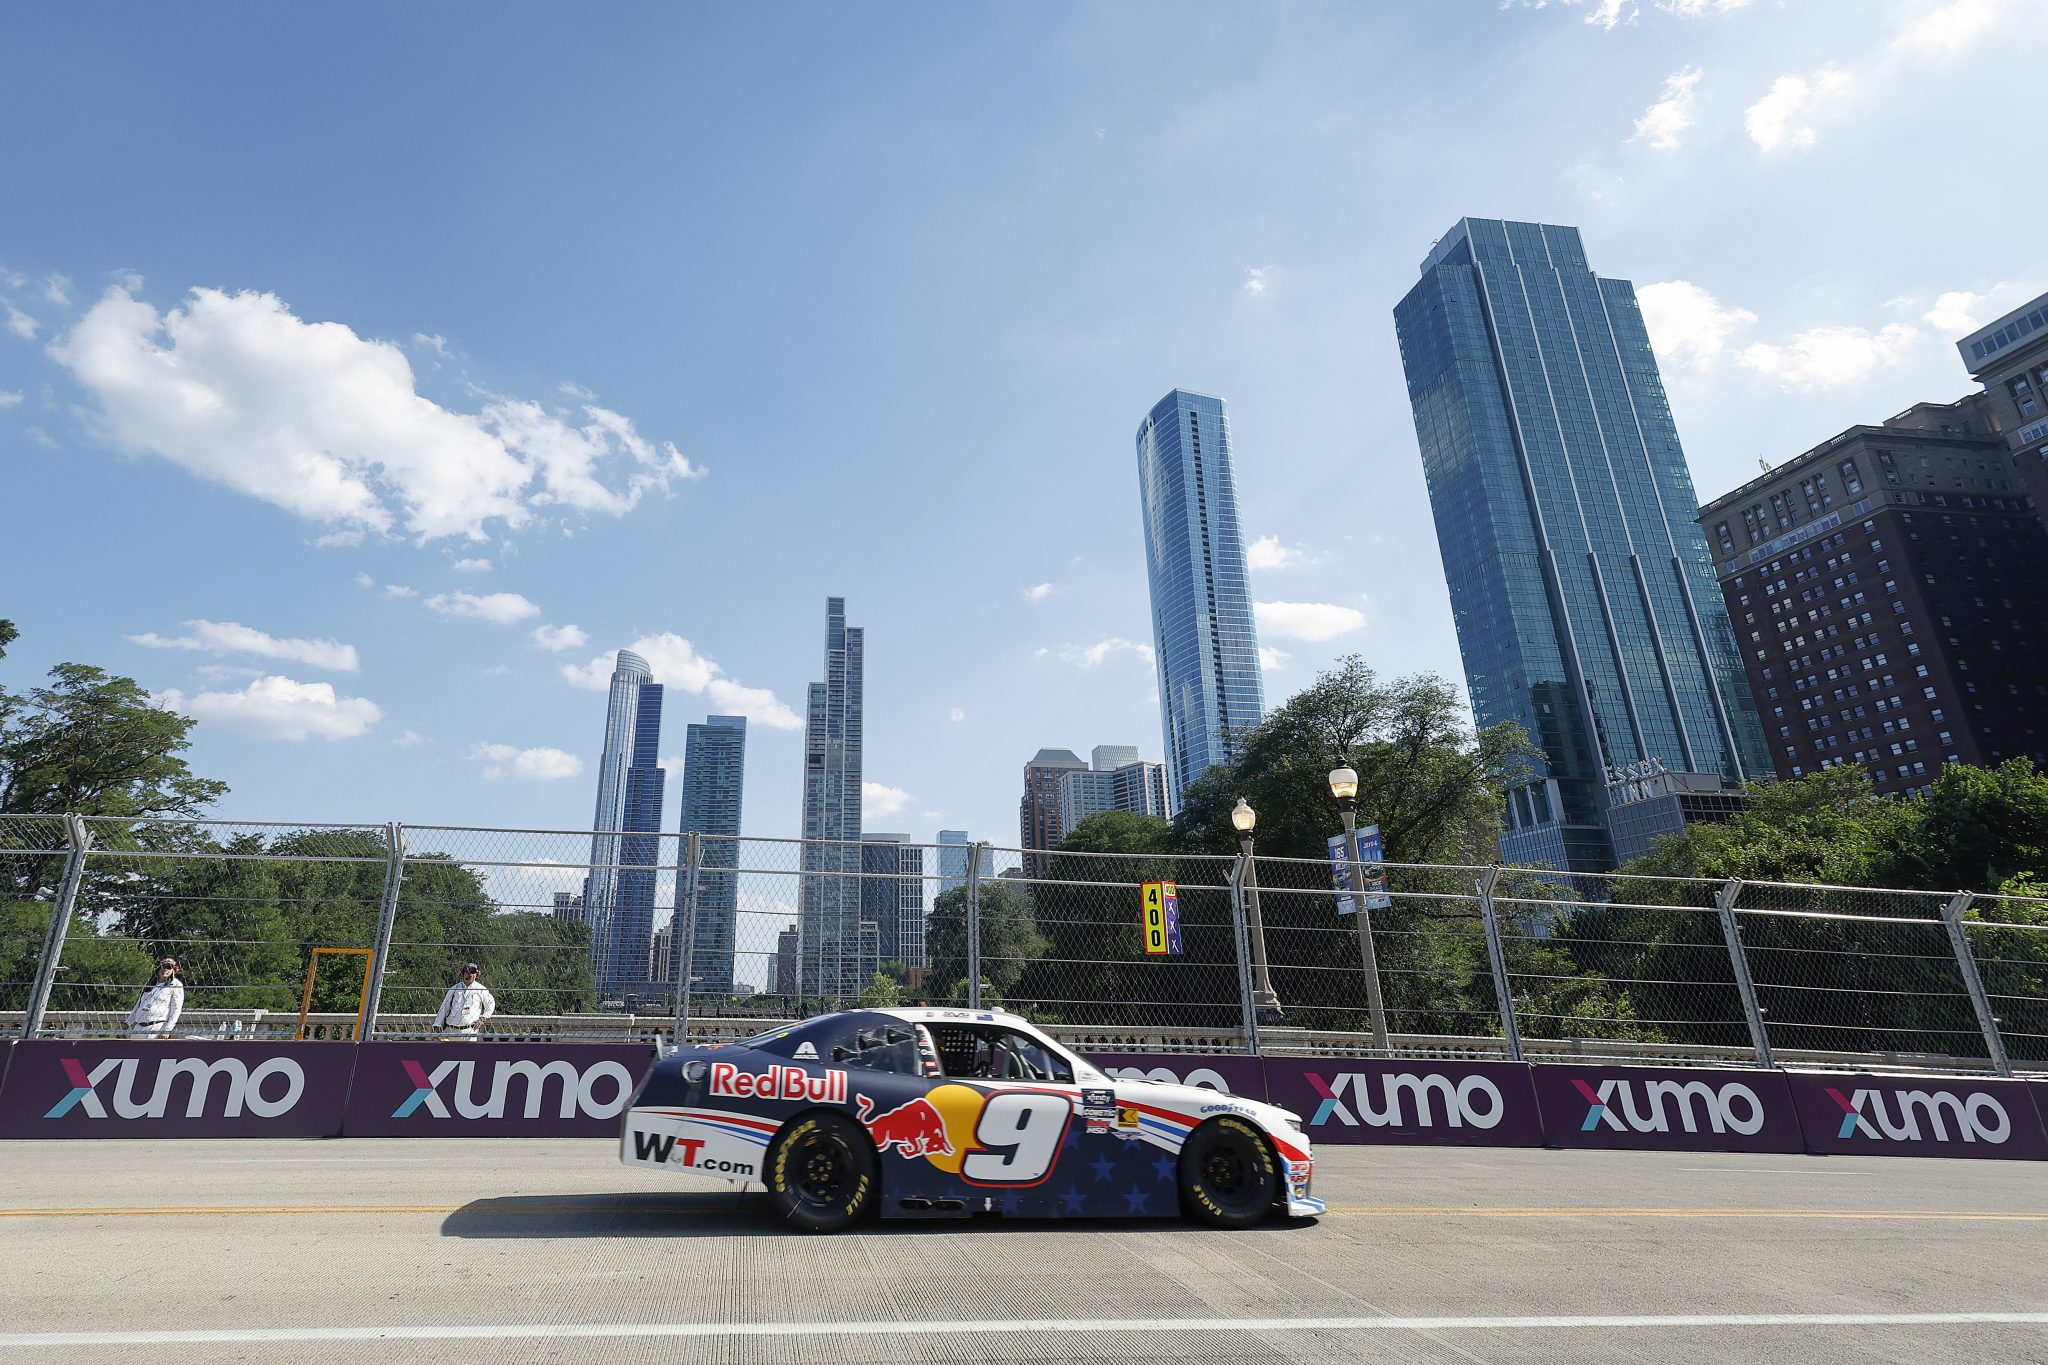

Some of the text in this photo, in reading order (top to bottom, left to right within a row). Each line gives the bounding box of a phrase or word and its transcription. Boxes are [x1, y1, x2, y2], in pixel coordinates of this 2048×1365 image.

[1602, 755, 1667, 788] ESSEX
[1148, 888, 1161, 947] 400
[962, 1091, 1072, 1184] 9
